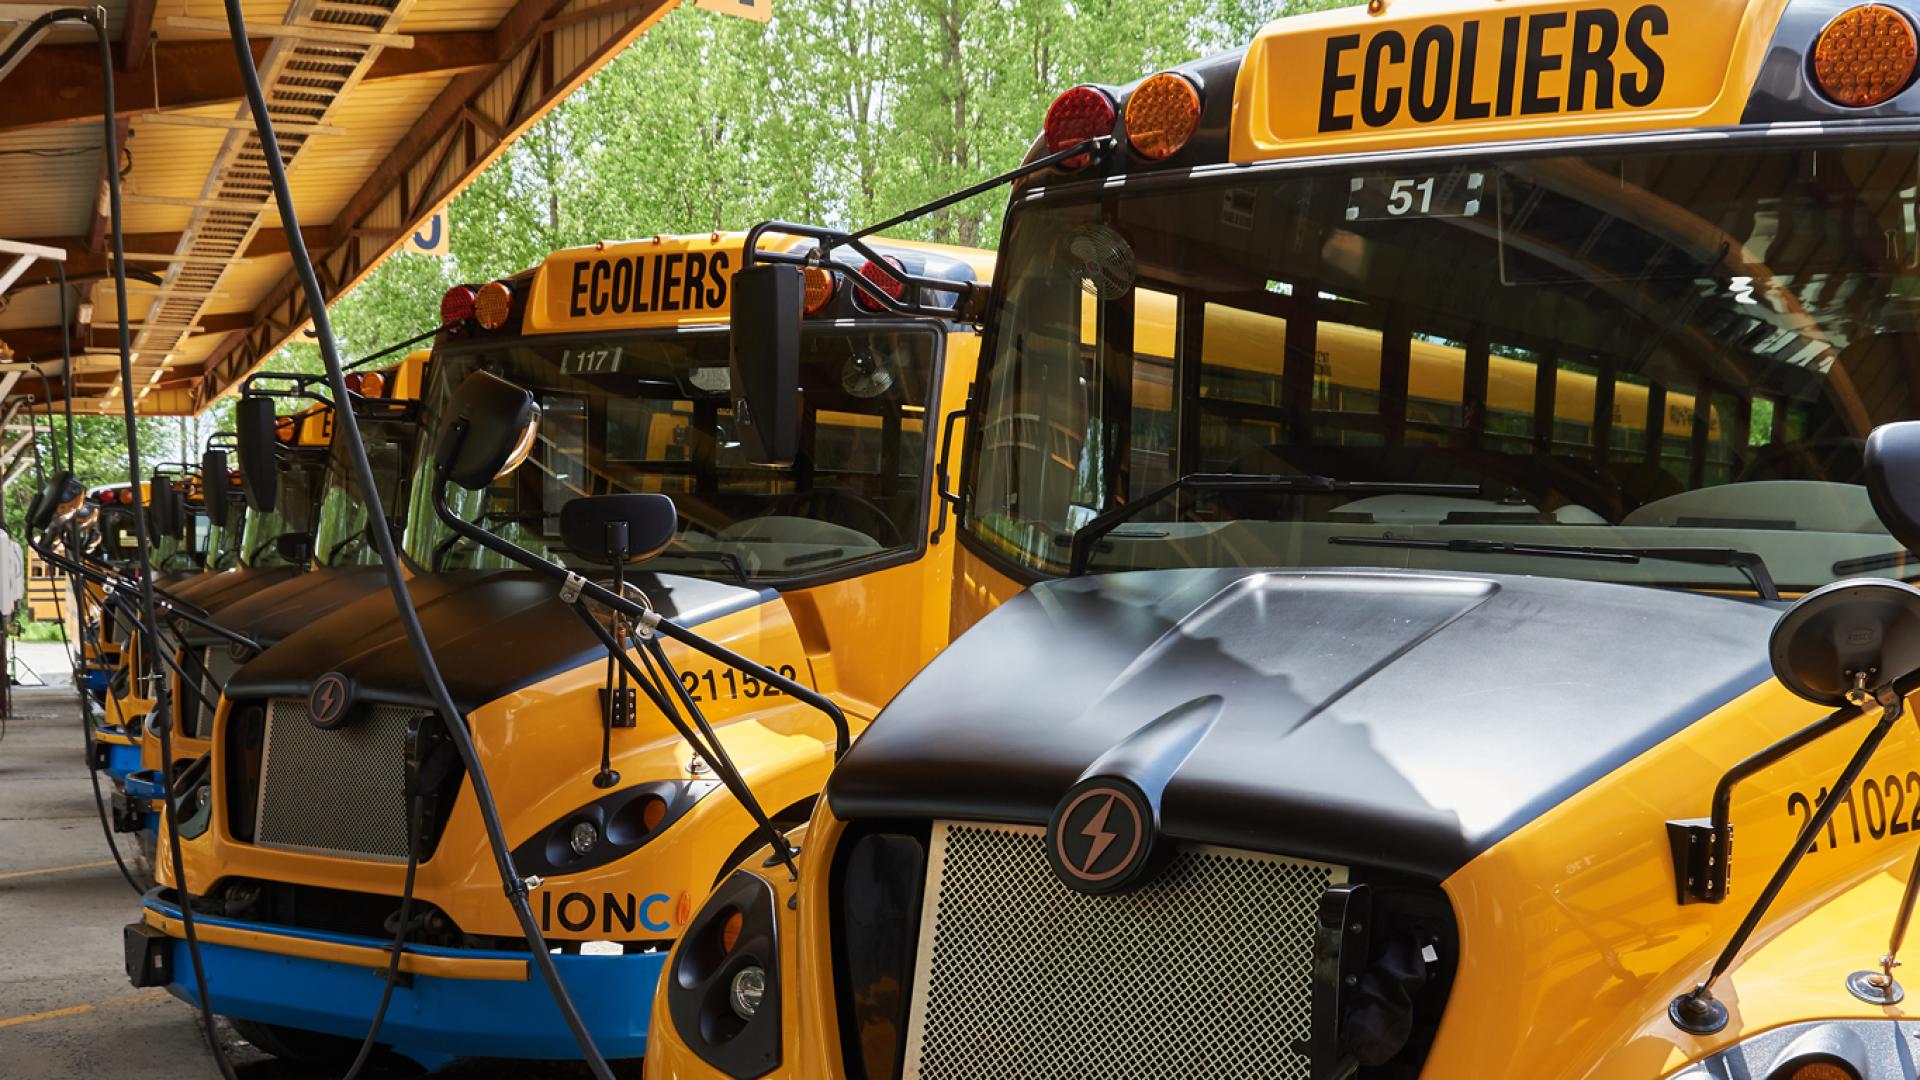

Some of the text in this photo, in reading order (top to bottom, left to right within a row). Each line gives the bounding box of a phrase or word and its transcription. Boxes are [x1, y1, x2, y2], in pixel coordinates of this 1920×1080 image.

[1318, 4, 1669, 133] ECOLIERS
[1386, 177, 1435, 216] 51
[570, 251, 729, 318] ECOLIERS
[577, 351, 609, 372] 117
[541, 890, 671, 933] IONC
